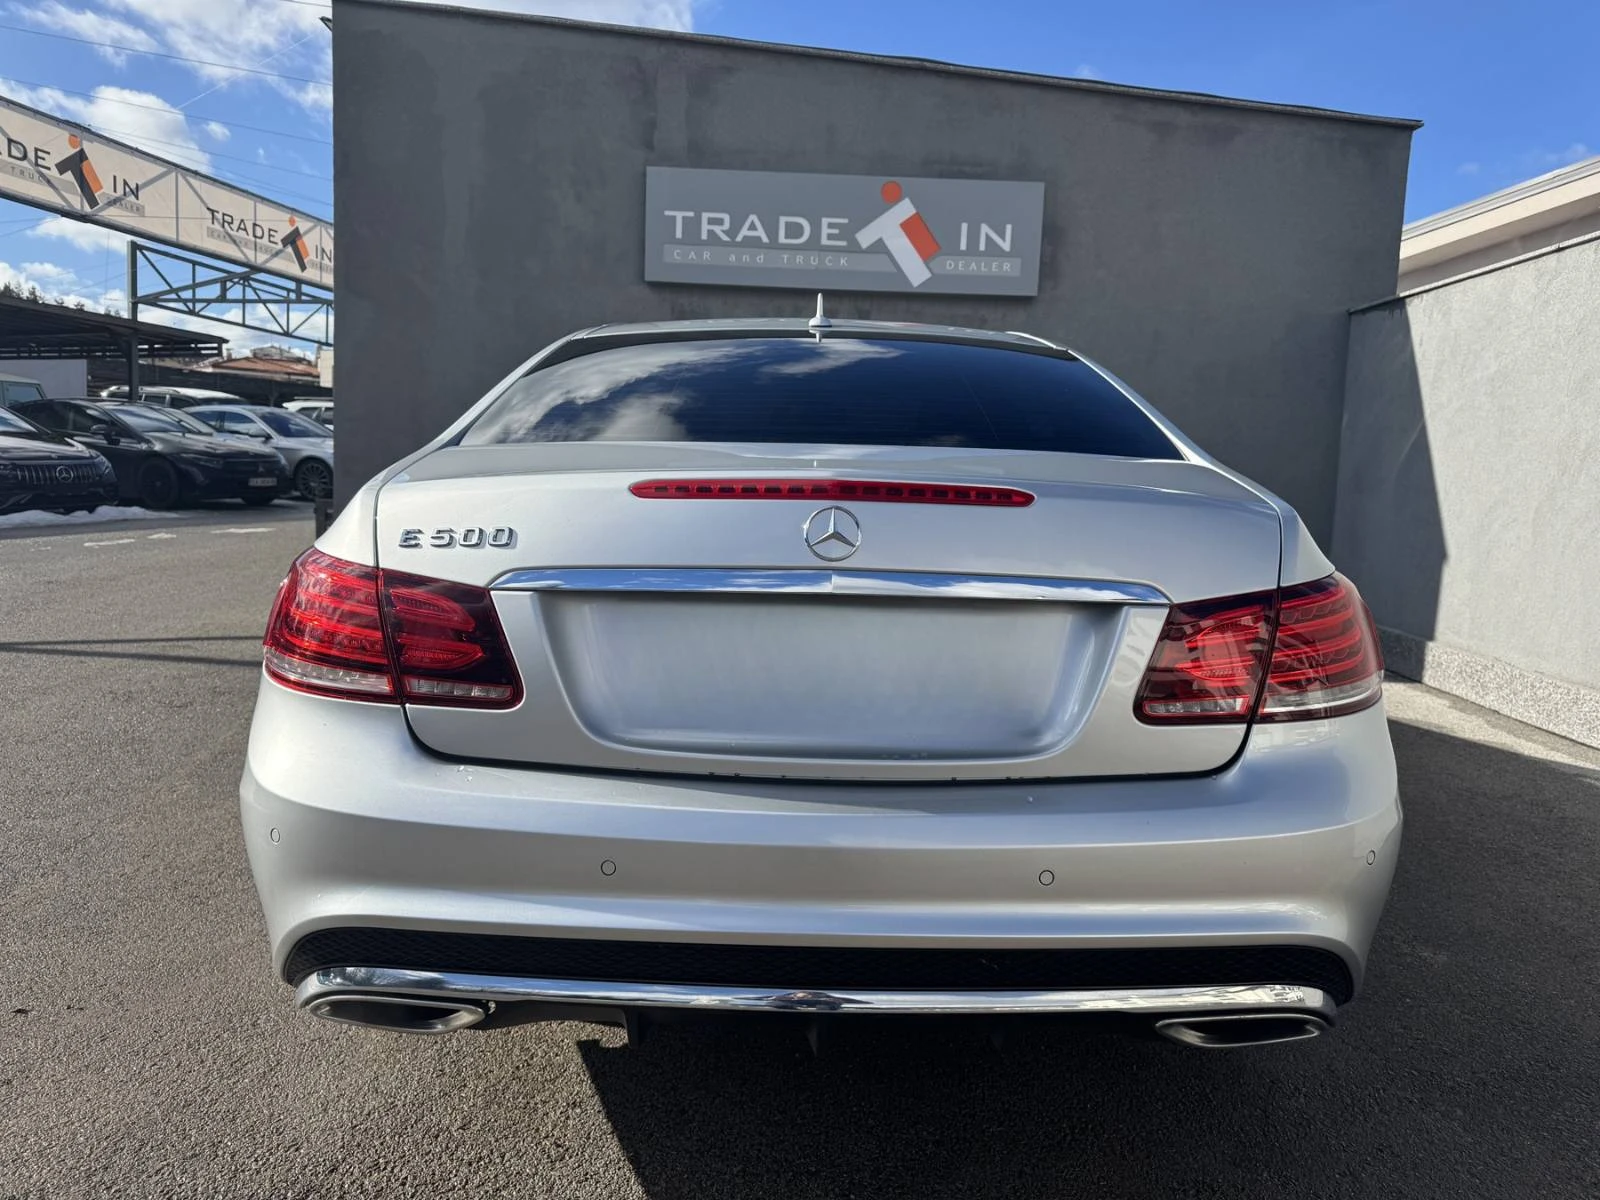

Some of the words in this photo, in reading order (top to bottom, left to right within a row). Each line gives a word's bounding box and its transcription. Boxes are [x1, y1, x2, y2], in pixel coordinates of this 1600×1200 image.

[0, 137, 51, 171] DE
[113, 174, 139, 201] IN
[206, 207, 279, 245] TRADE
[315, 244, 332, 263] IN
[664, 210, 849, 246] TRADE
[960, 222, 1012, 252] IN
[674, 250, 712, 261] CAR
[728, 254, 764, 263] and
[782, 254, 848, 266] TRUCK
[946, 260, 1012, 272] DEALER
[430, 527, 518, 549] 500
